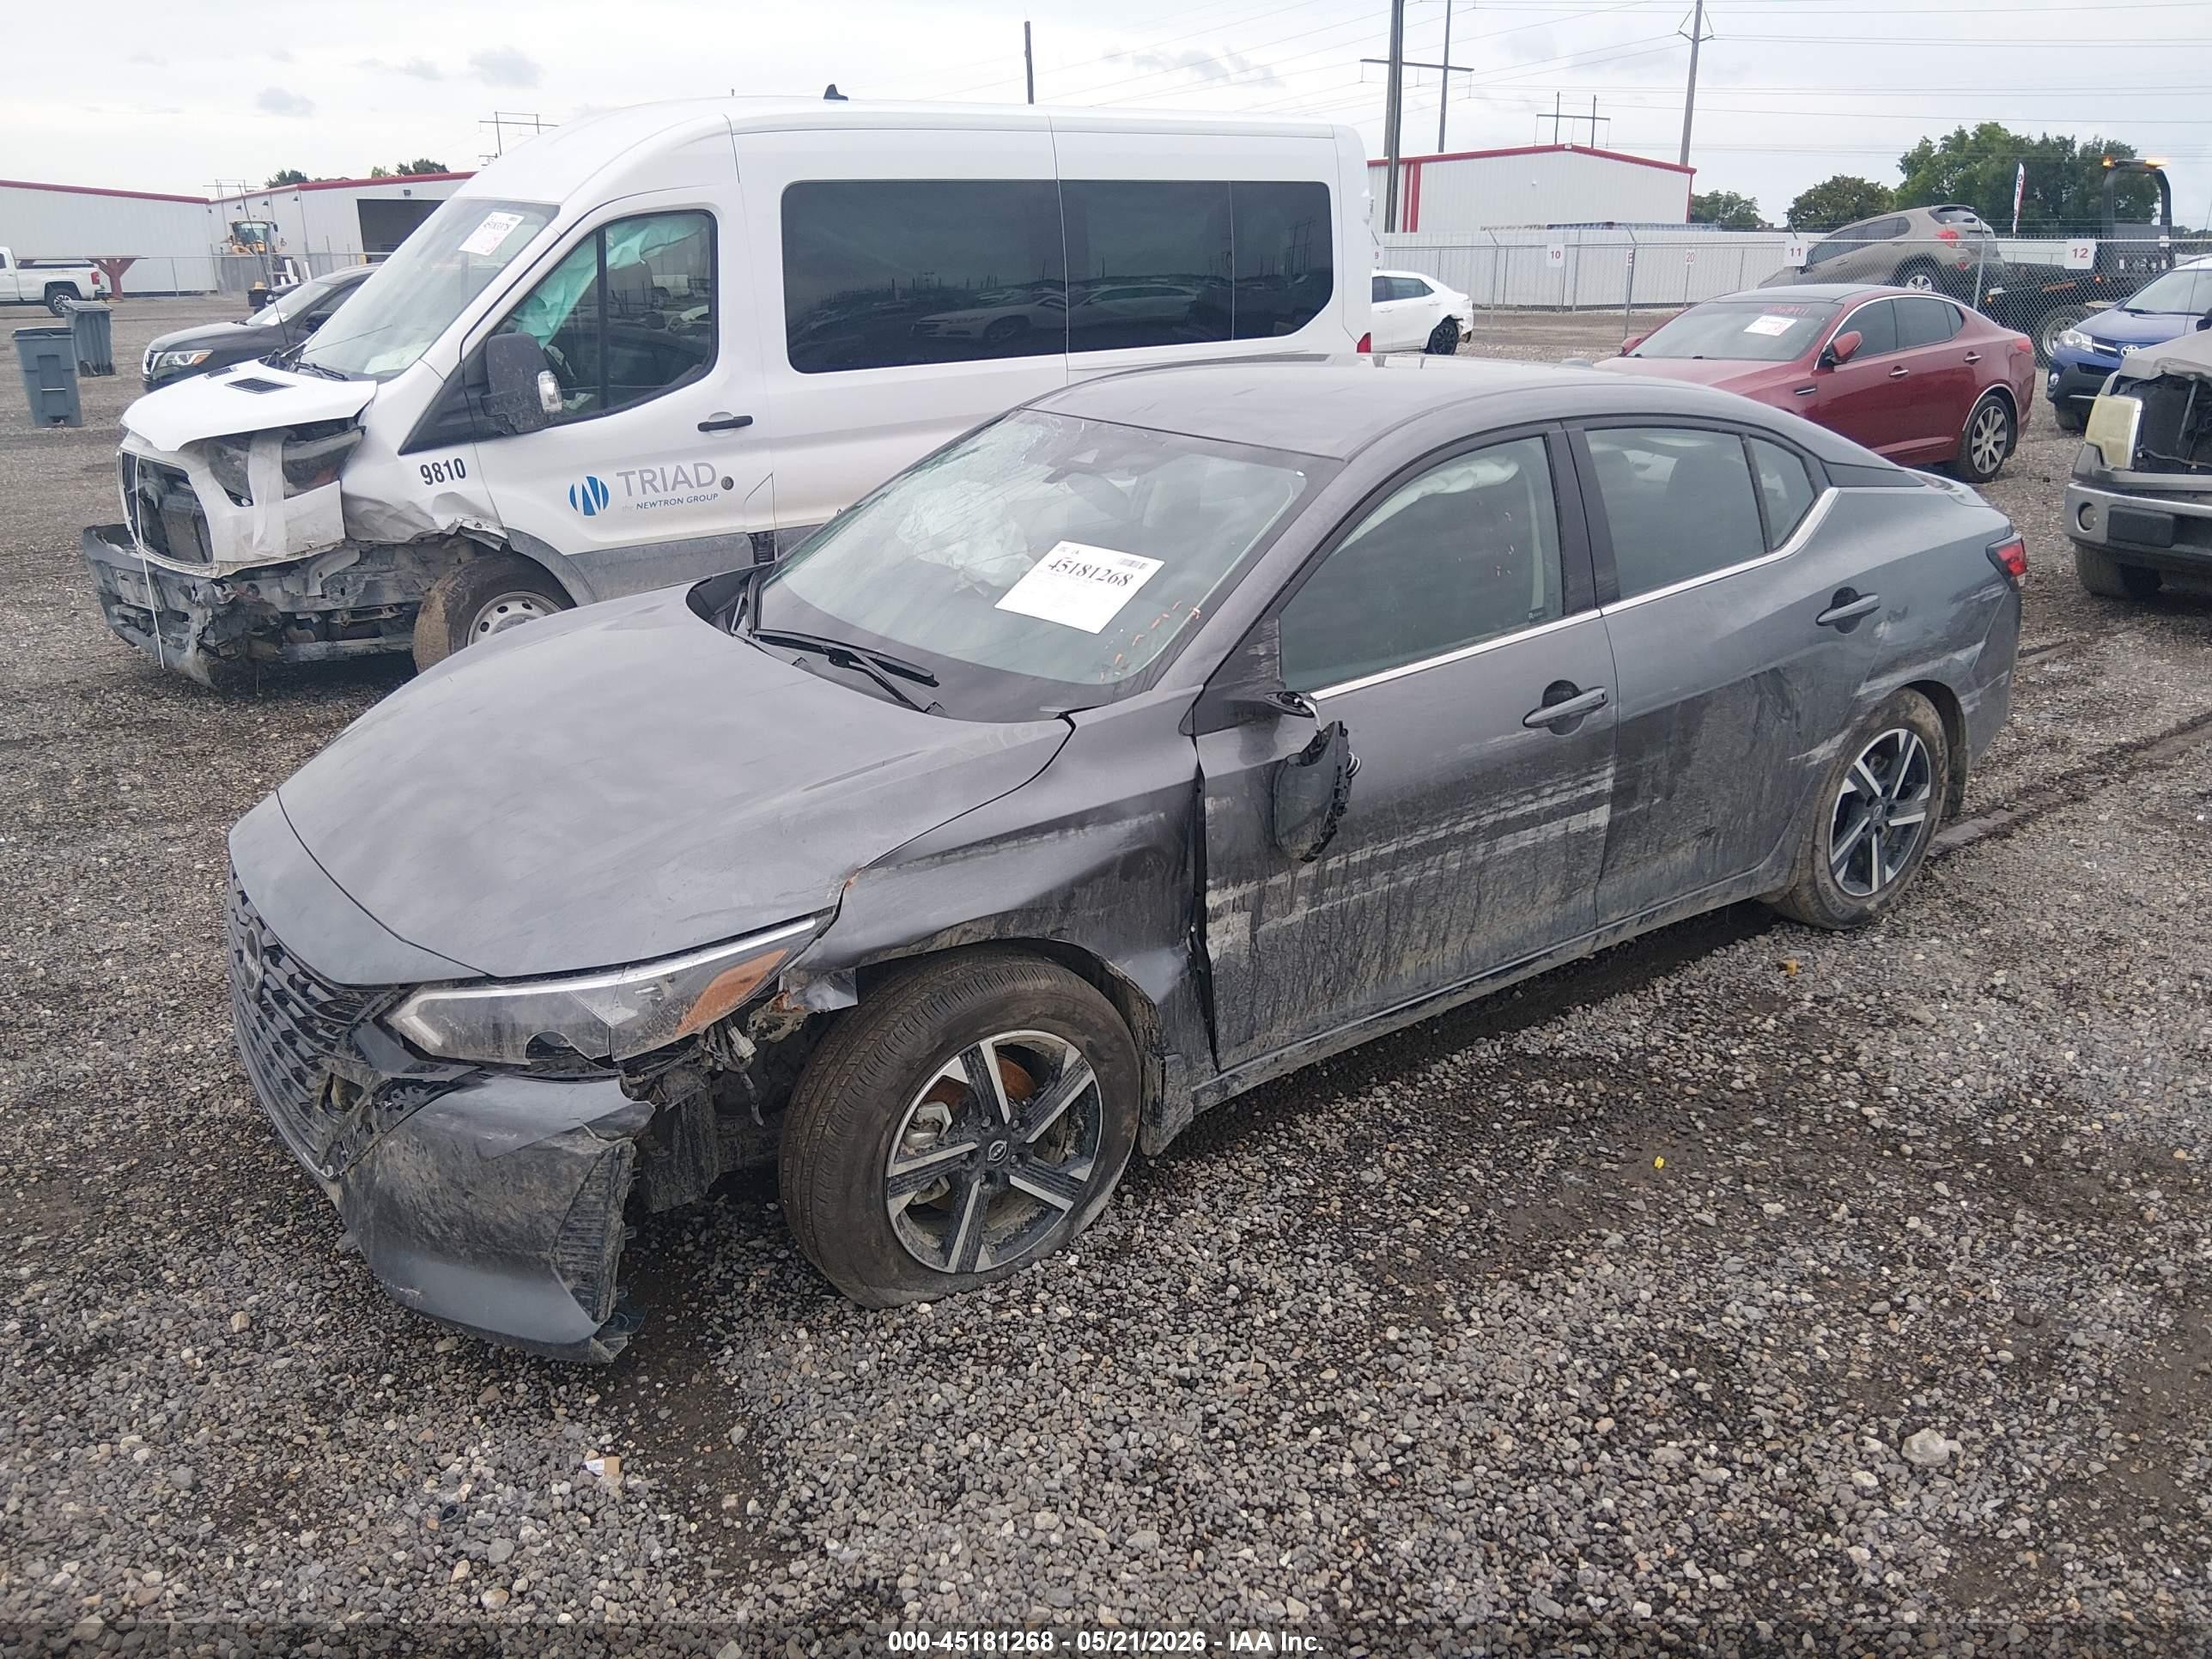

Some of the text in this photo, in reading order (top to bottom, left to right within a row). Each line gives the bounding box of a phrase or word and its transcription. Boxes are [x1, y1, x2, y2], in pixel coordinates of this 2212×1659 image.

[1790, 247, 1801, 257] 11
[2072, 247, 2088, 258] 12
[420, 458, 466, 485] 9810
[617, 462, 717, 496] TRIAD
[636, 497, 684, 510] NEWTRON
[686, 493, 719, 504] GROUP
[1048, 557, 1134, 586] 45181268
